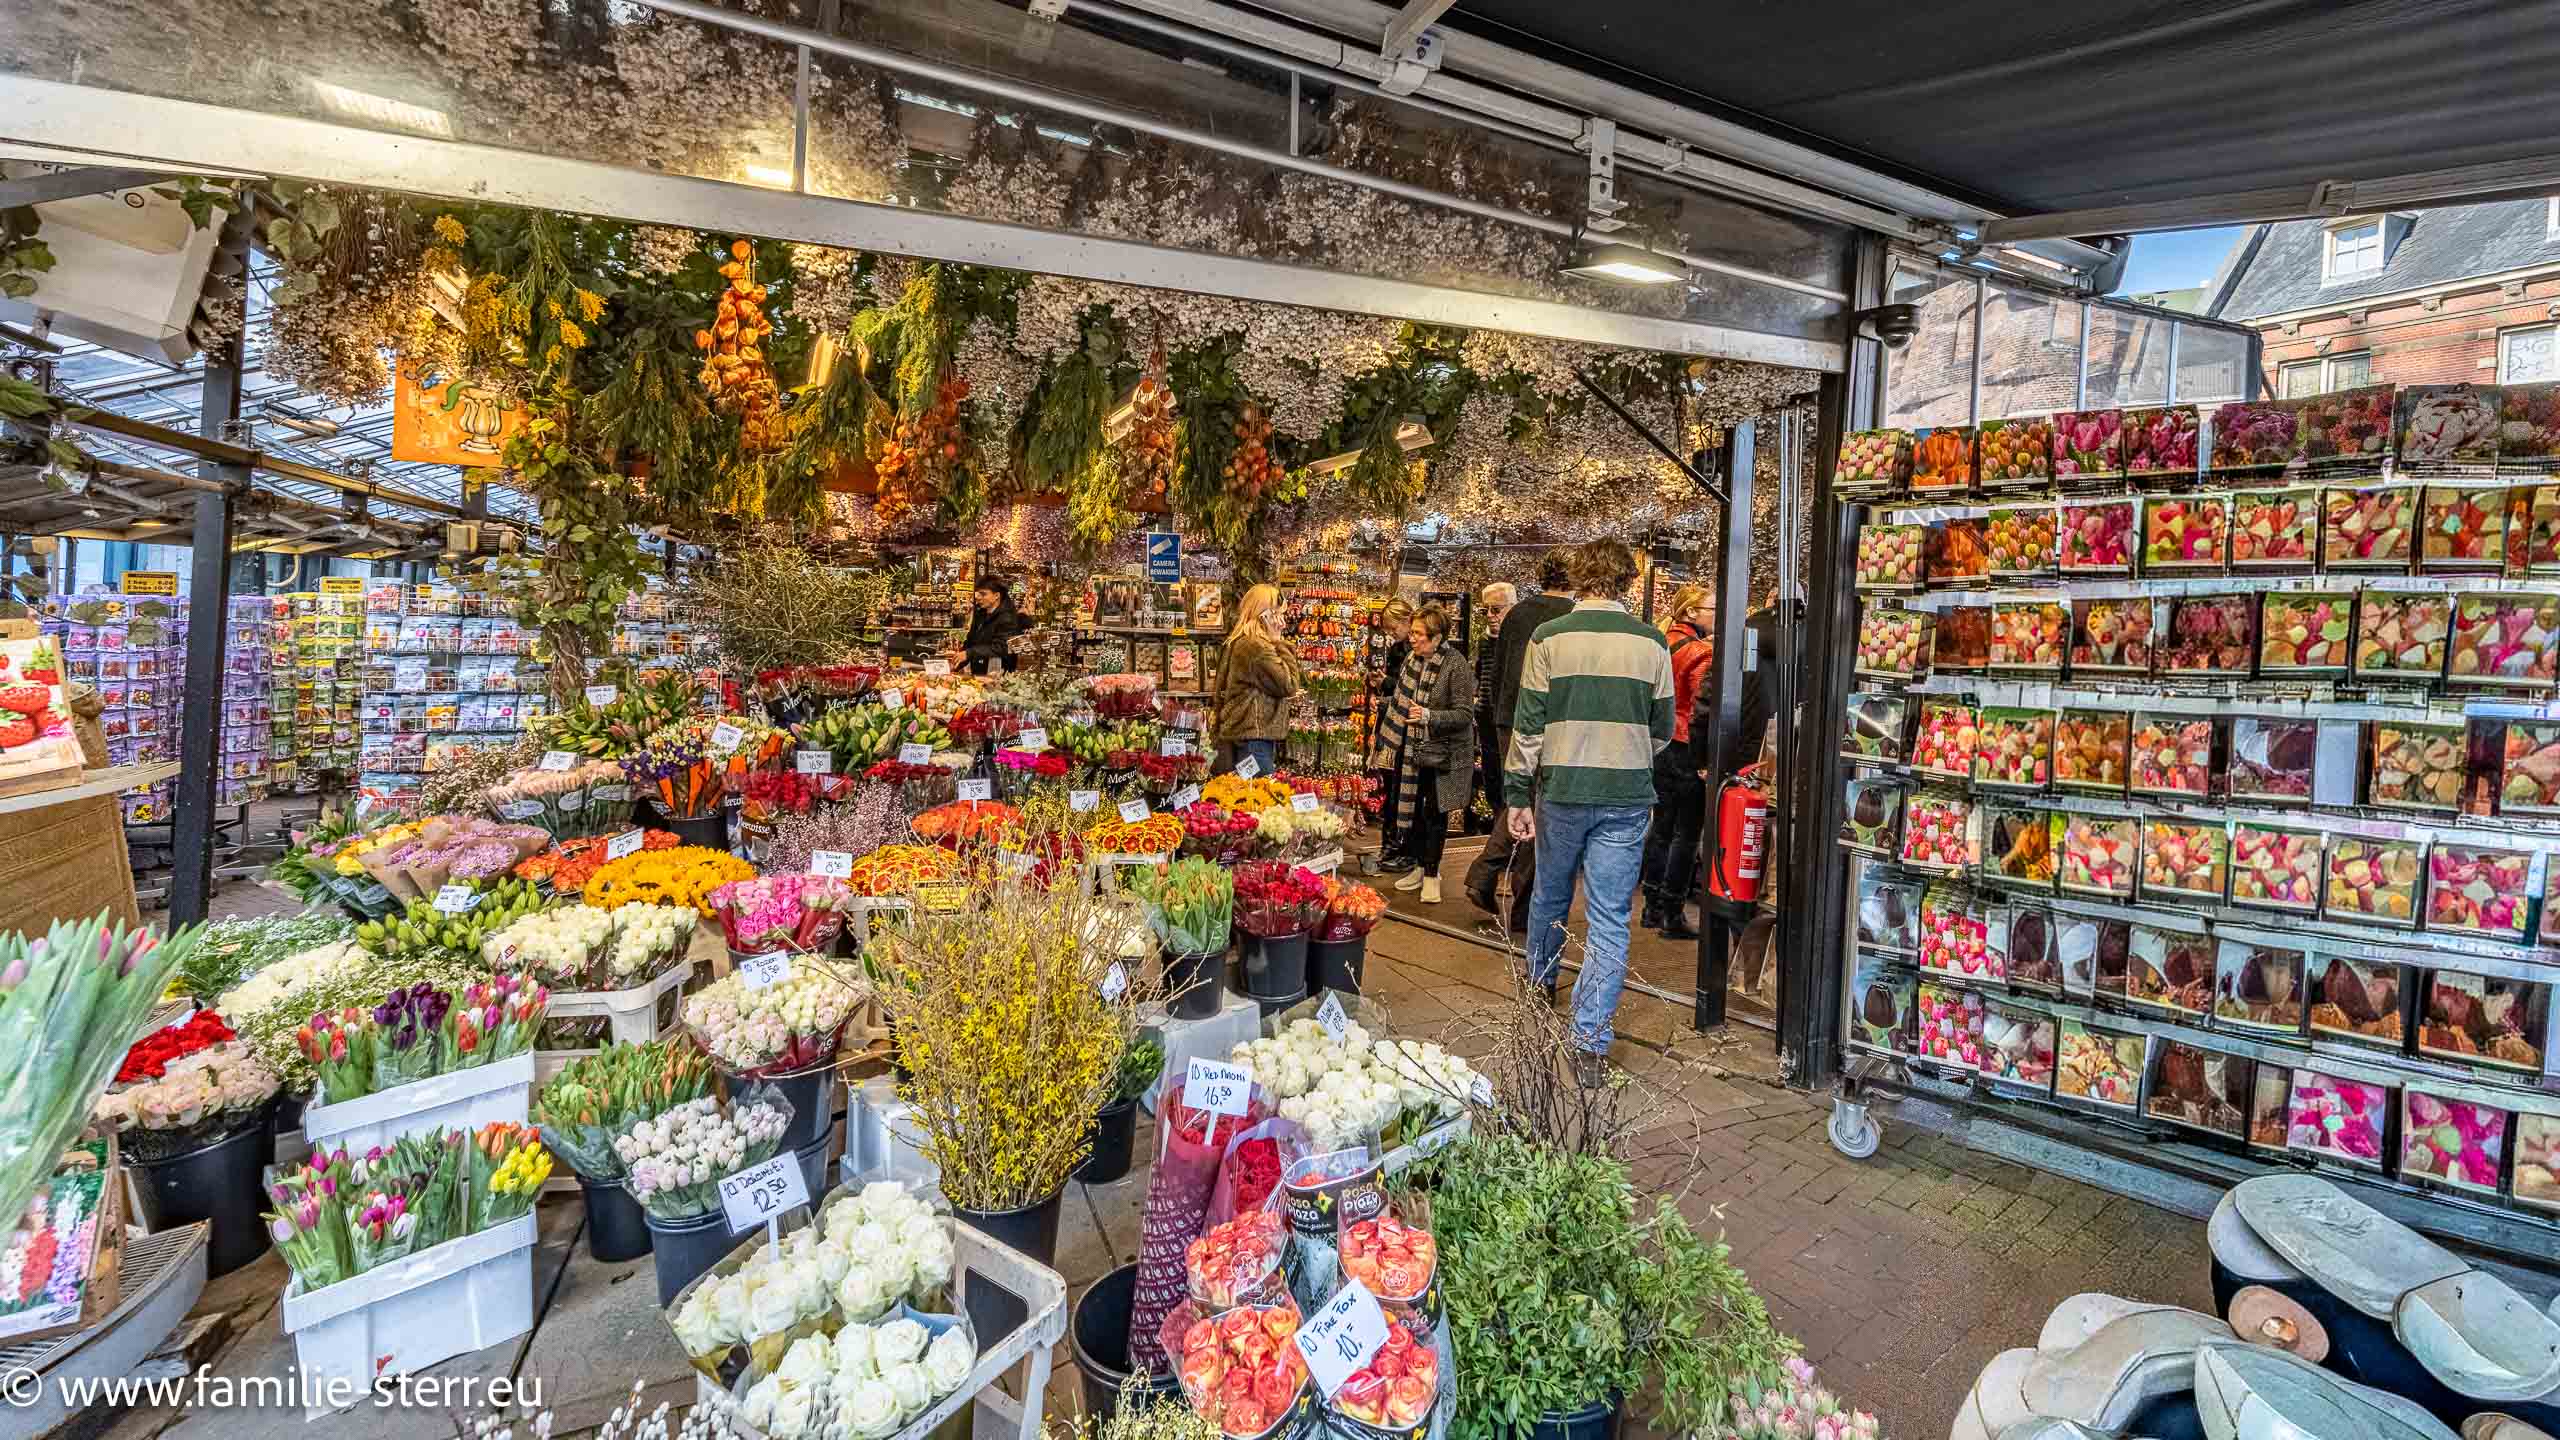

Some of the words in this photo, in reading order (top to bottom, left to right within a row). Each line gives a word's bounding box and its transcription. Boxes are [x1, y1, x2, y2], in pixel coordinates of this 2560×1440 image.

[1151, 568, 1179, 576] BEWAKING
[1191, 1063, 1201, 1081] 10
[722, 1181, 739, 1199] 10
[1299, 1335, 1318, 1357] 10
